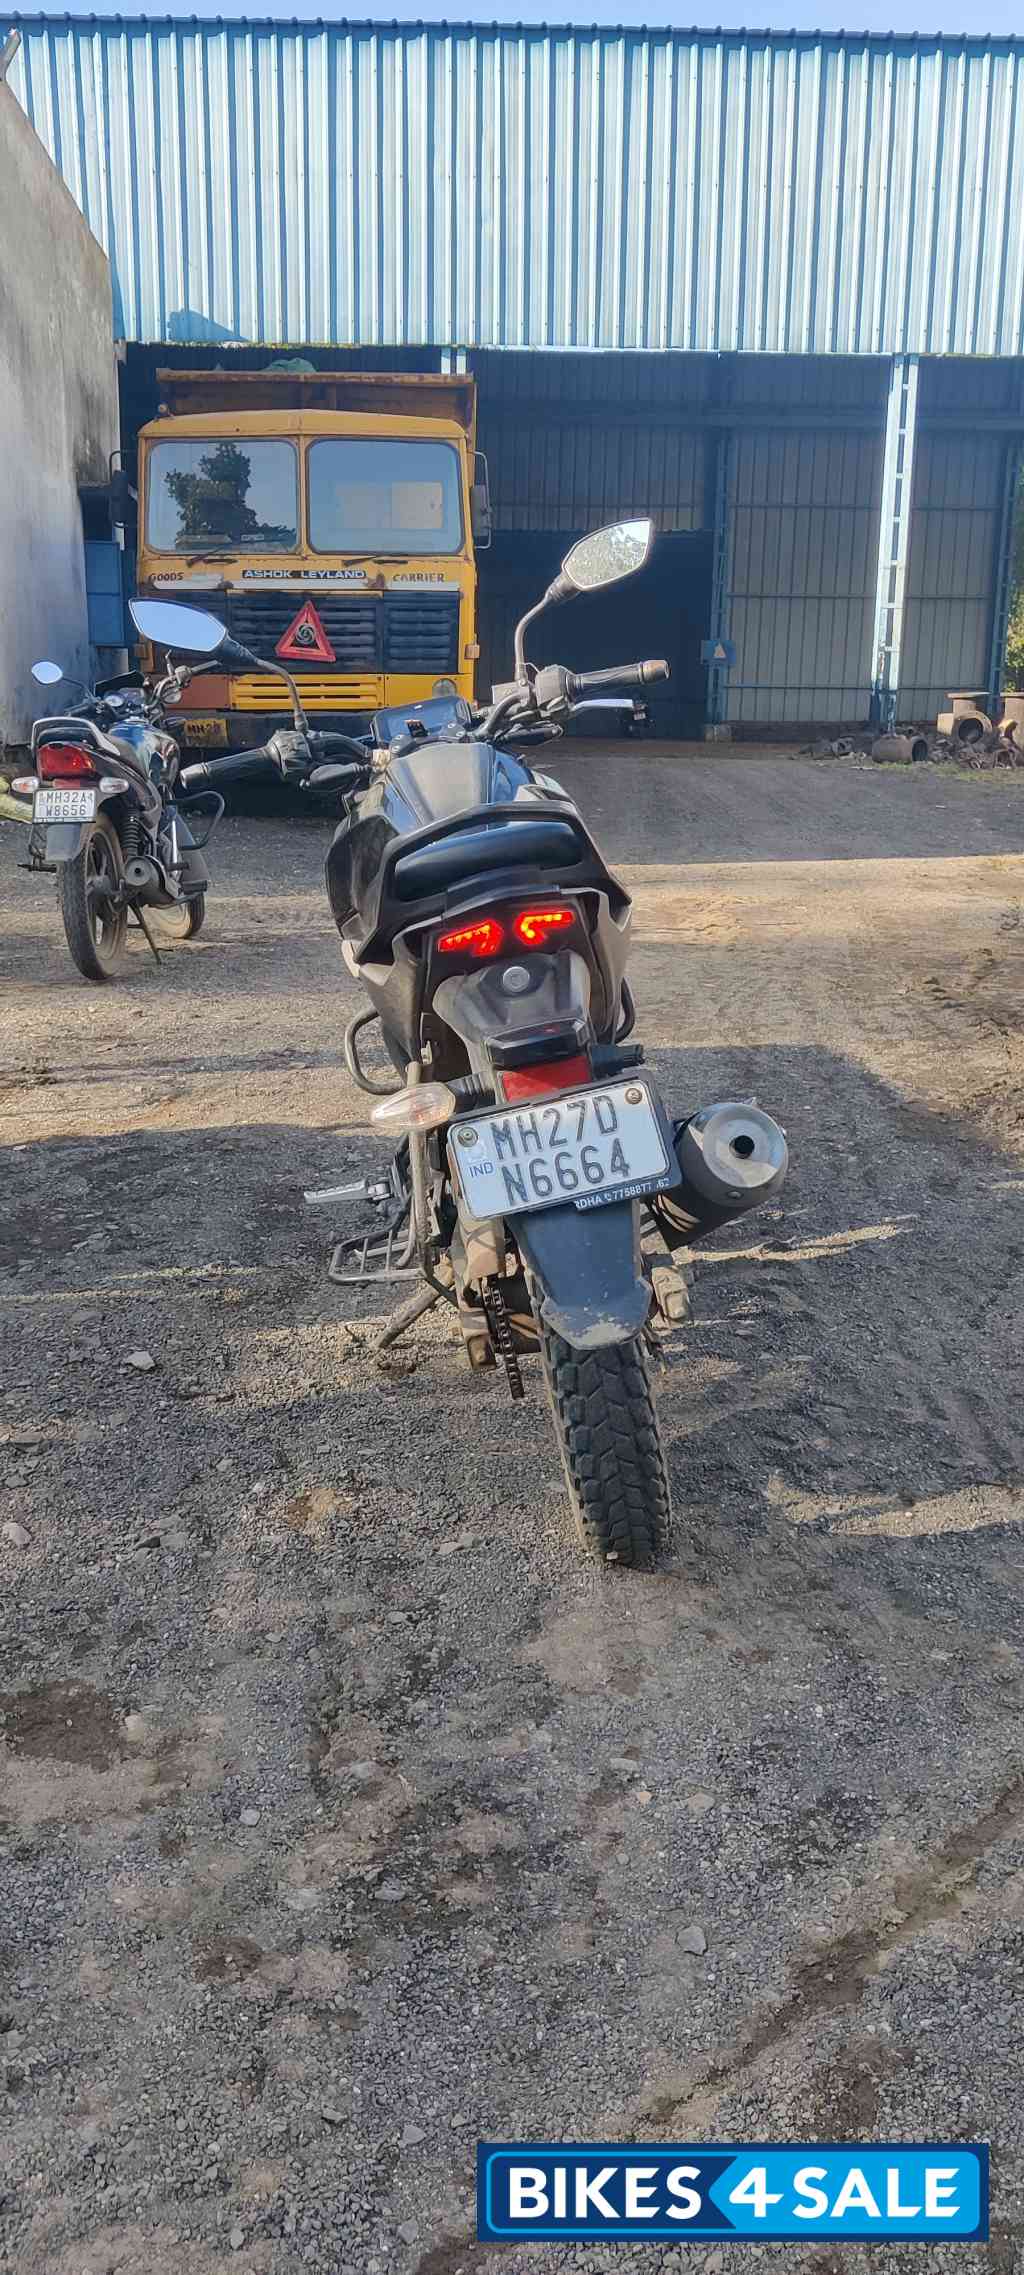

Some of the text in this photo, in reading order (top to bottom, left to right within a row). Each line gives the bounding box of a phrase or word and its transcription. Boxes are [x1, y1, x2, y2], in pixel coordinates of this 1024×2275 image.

[149, 572, 184, 582] GOODS
[244, 570, 365, 579] ASHOK LEYLAND
[393, 573, 445, 583] CARRIER
[46, 791, 86, 804] MH32A
[46, 805, 86, 817] W8656
[490, 1094, 618, 1161] MH27D
[468, 1161, 494, 1178] IND
[501, 1137, 630, 1206] N6664
